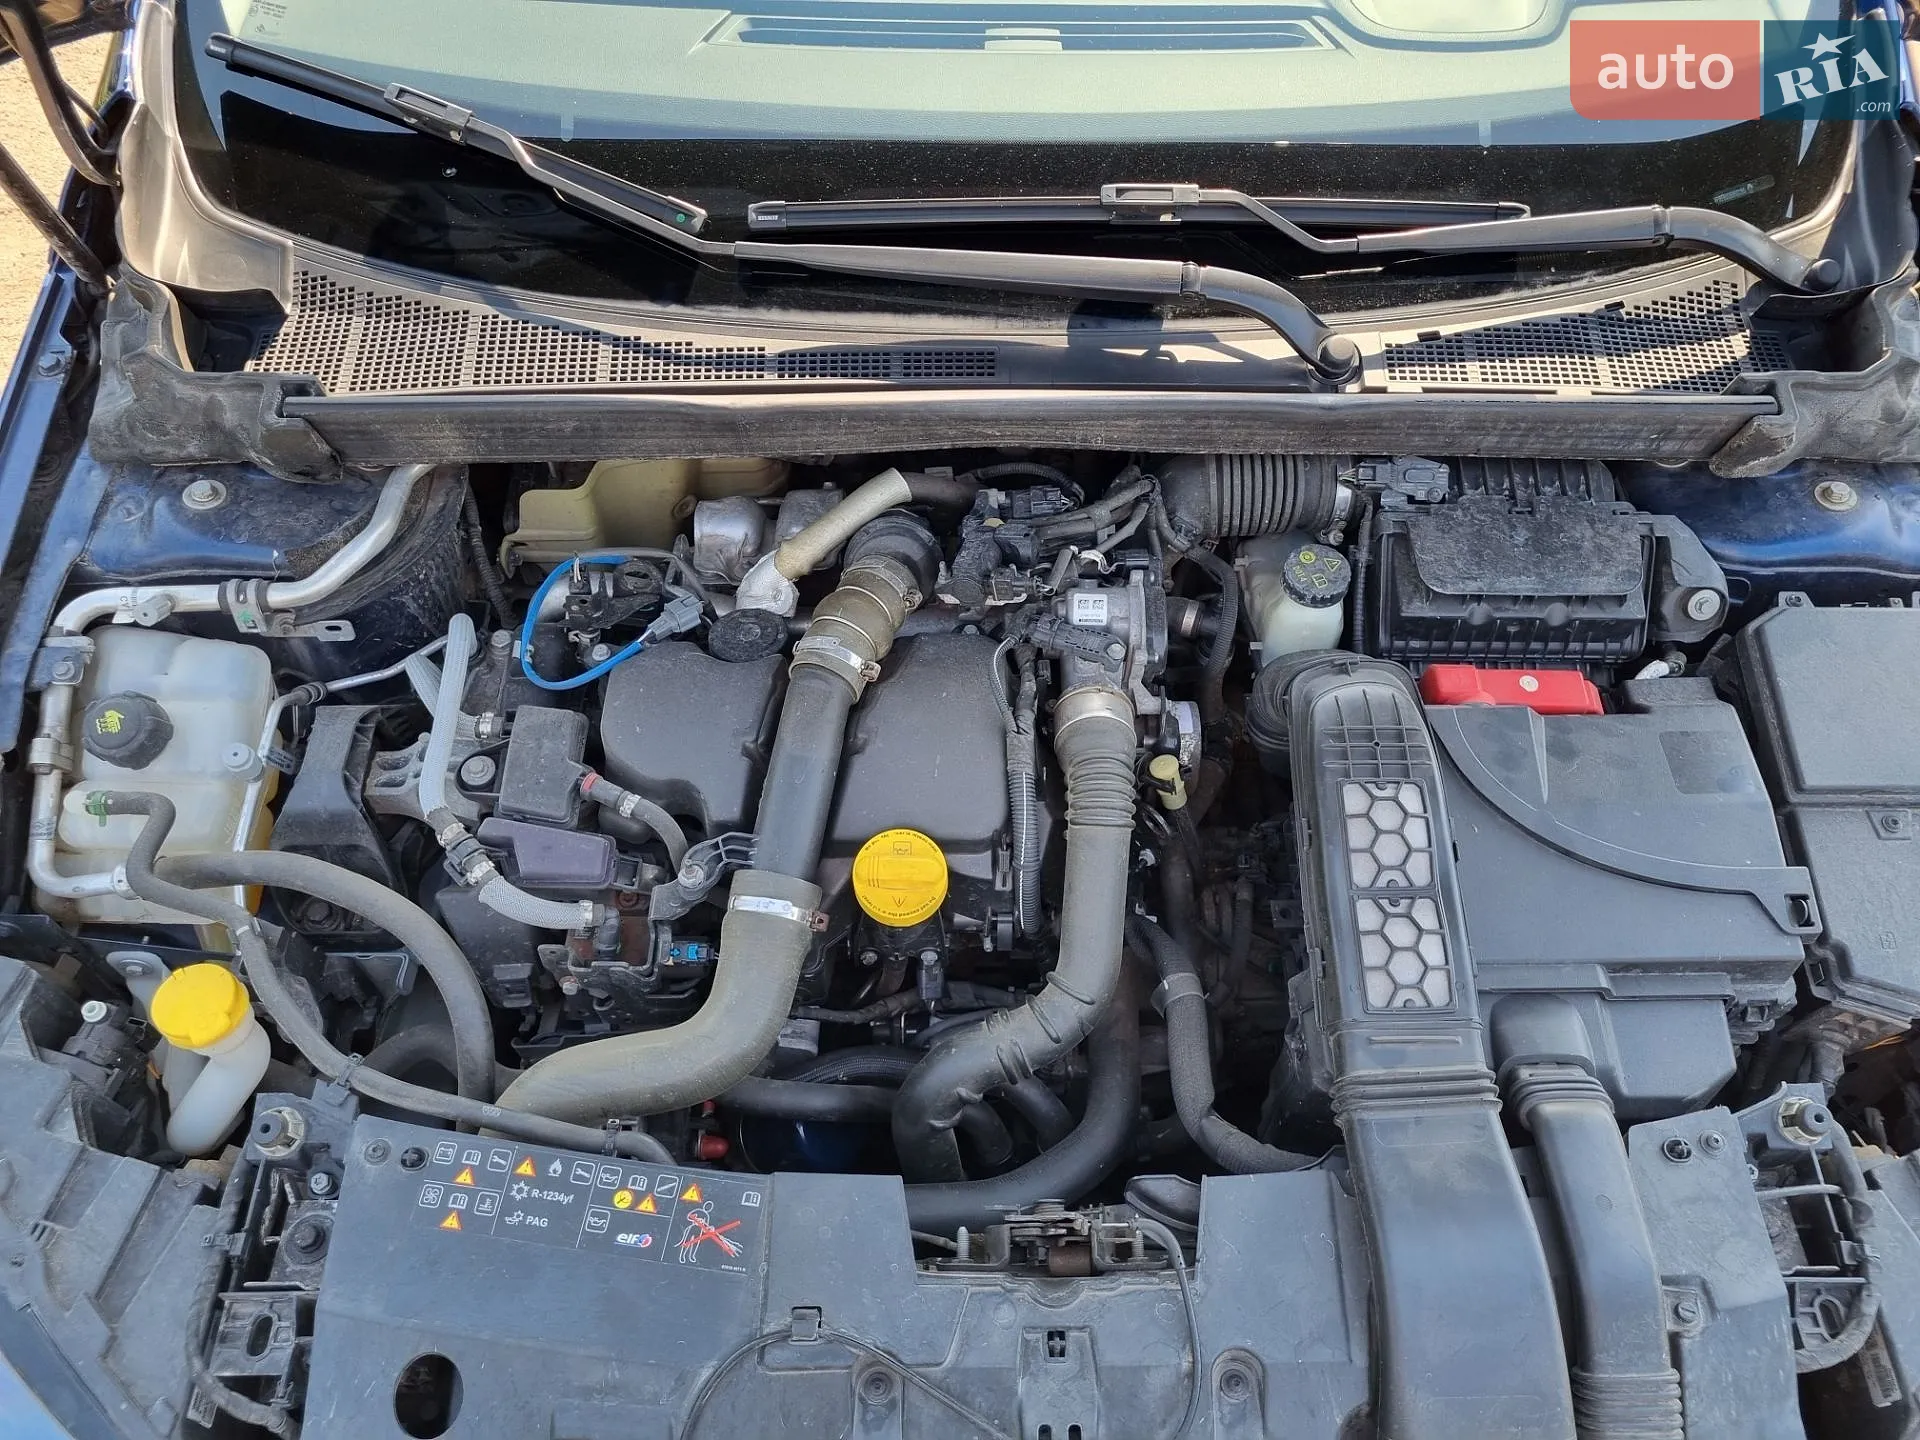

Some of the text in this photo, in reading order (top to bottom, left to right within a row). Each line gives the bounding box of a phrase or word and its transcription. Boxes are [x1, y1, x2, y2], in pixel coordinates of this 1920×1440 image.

[531, 1188, 575, 1205] R-1234yf
[525, 1215, 549, 1228] PAG
[616, 1233, 641, 1245] elf
